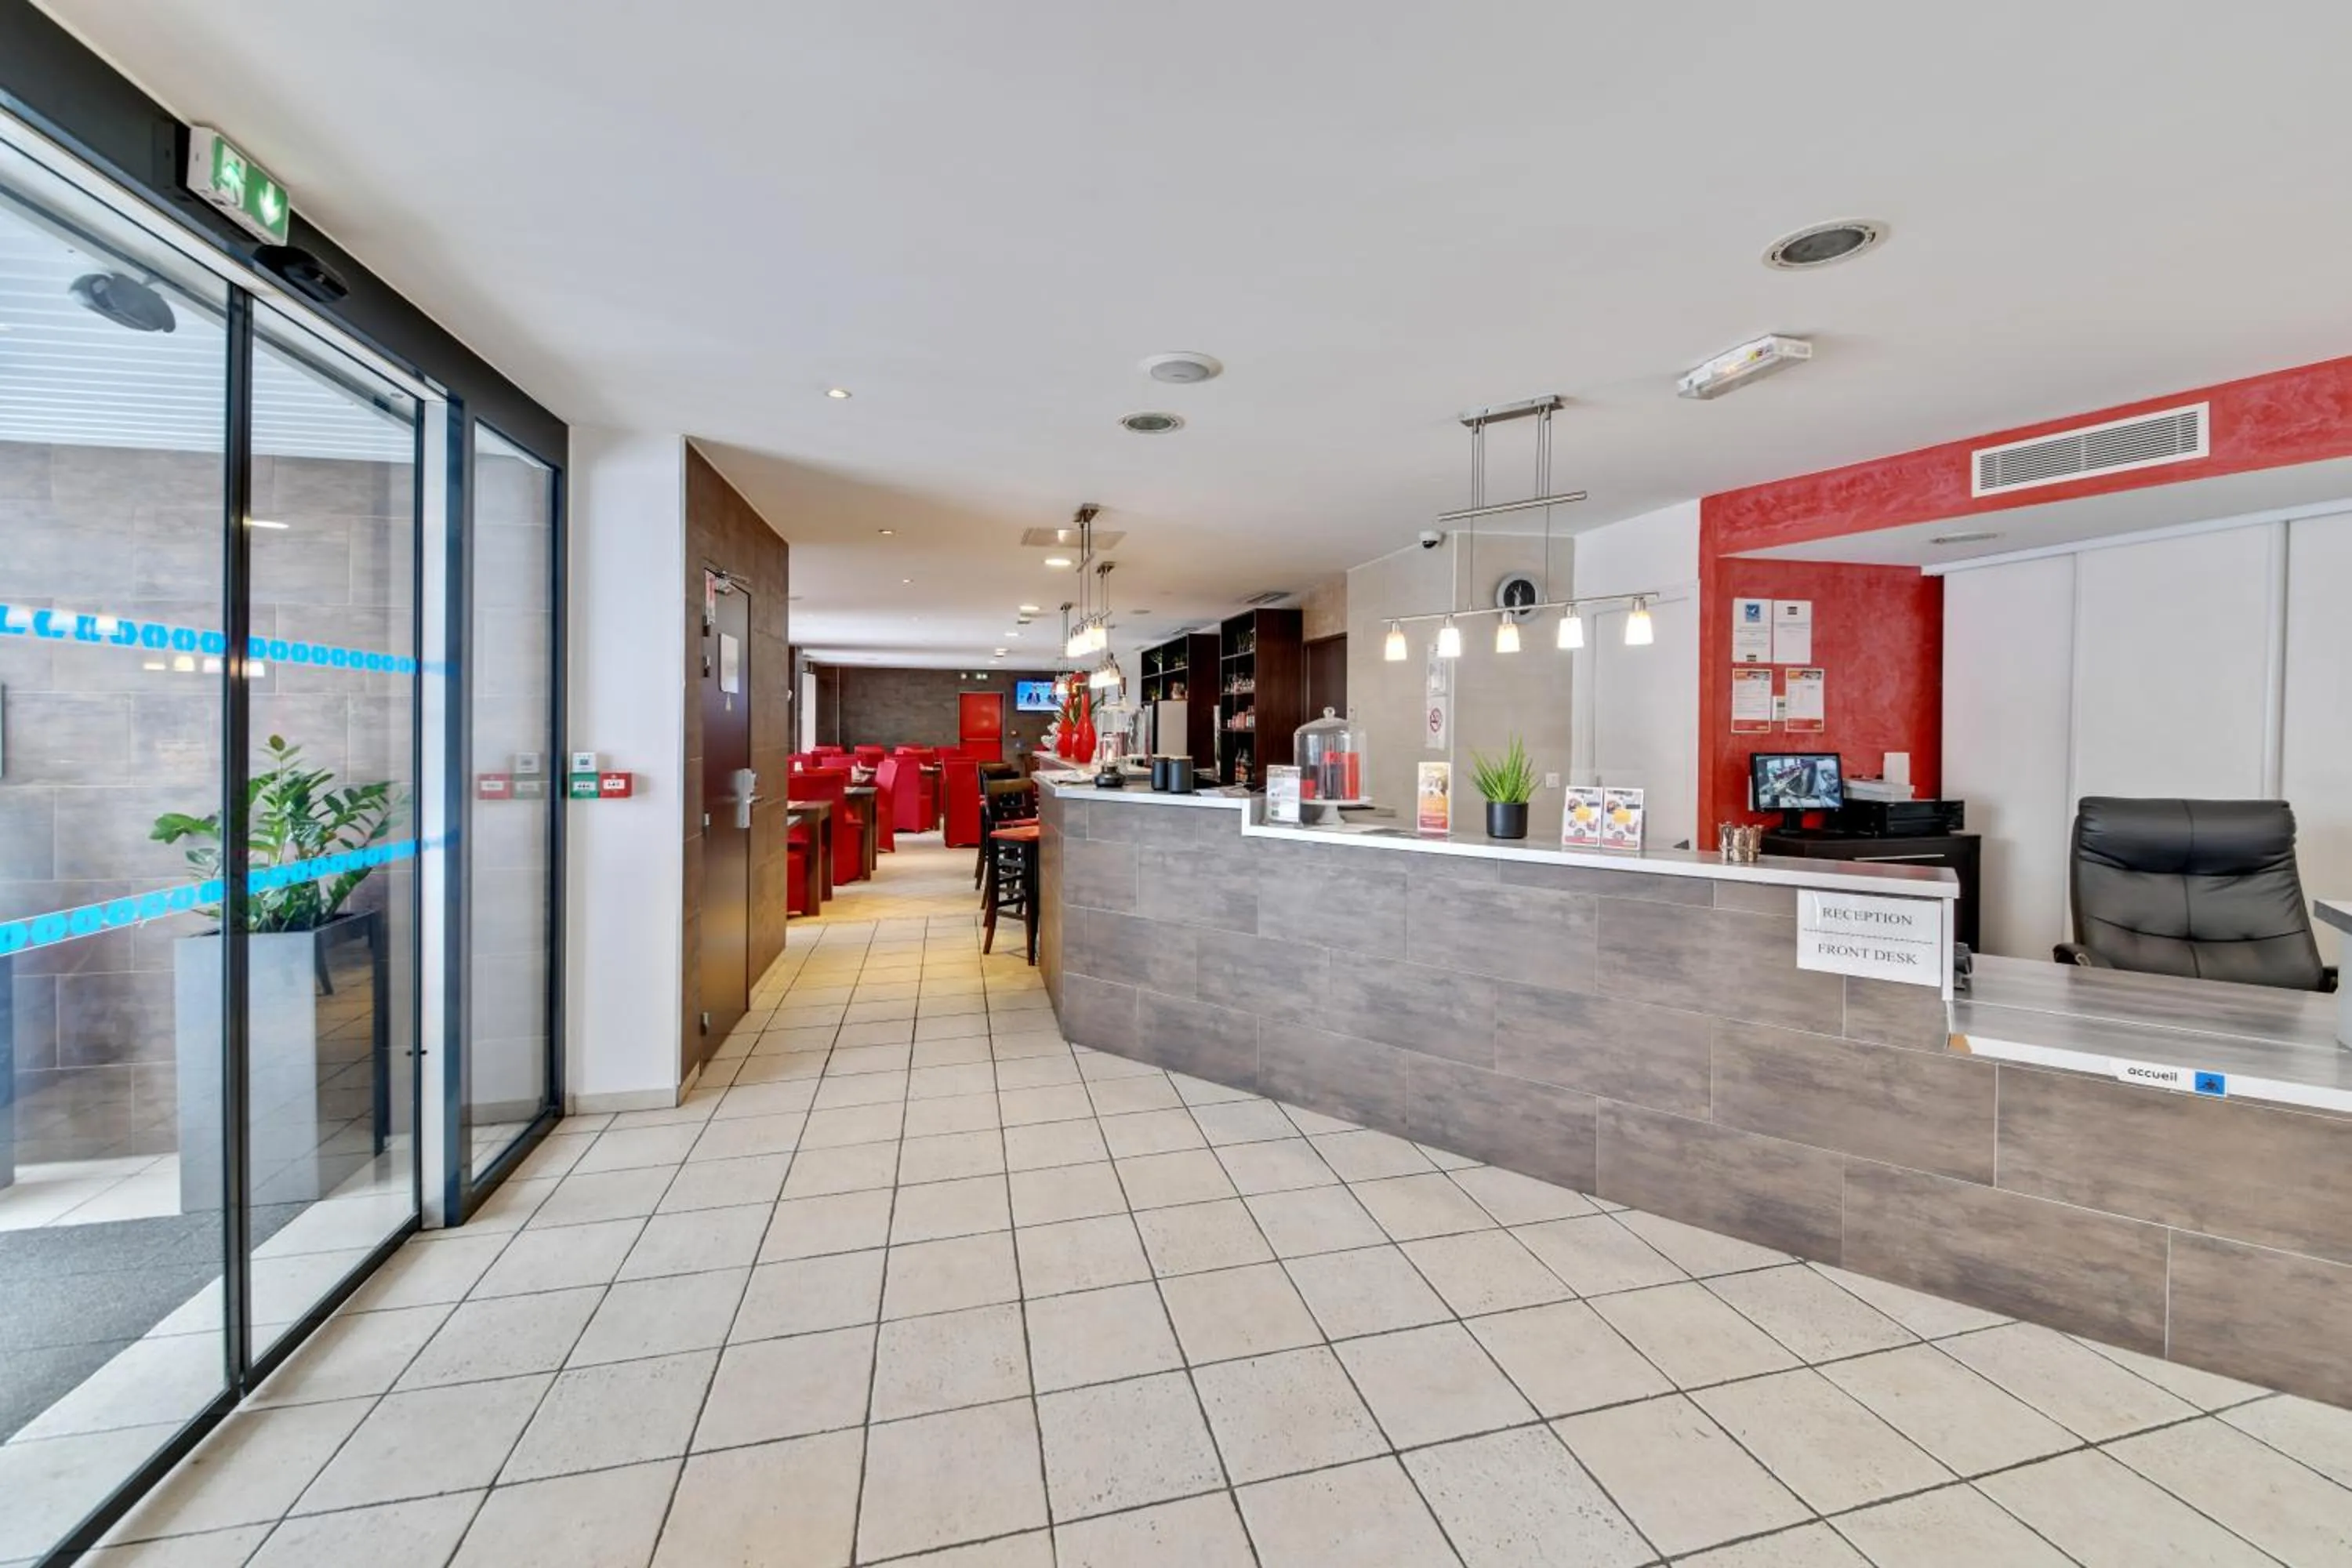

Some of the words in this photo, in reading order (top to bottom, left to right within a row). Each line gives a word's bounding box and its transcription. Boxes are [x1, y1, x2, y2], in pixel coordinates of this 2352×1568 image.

[1822, 907, 1913, 925] RECEPTION
[1818, 943, 1870, 960] FRONT
[1875, 949, 1918, 965] DESK
[2127, 1067, 2178, 1082] accueil
